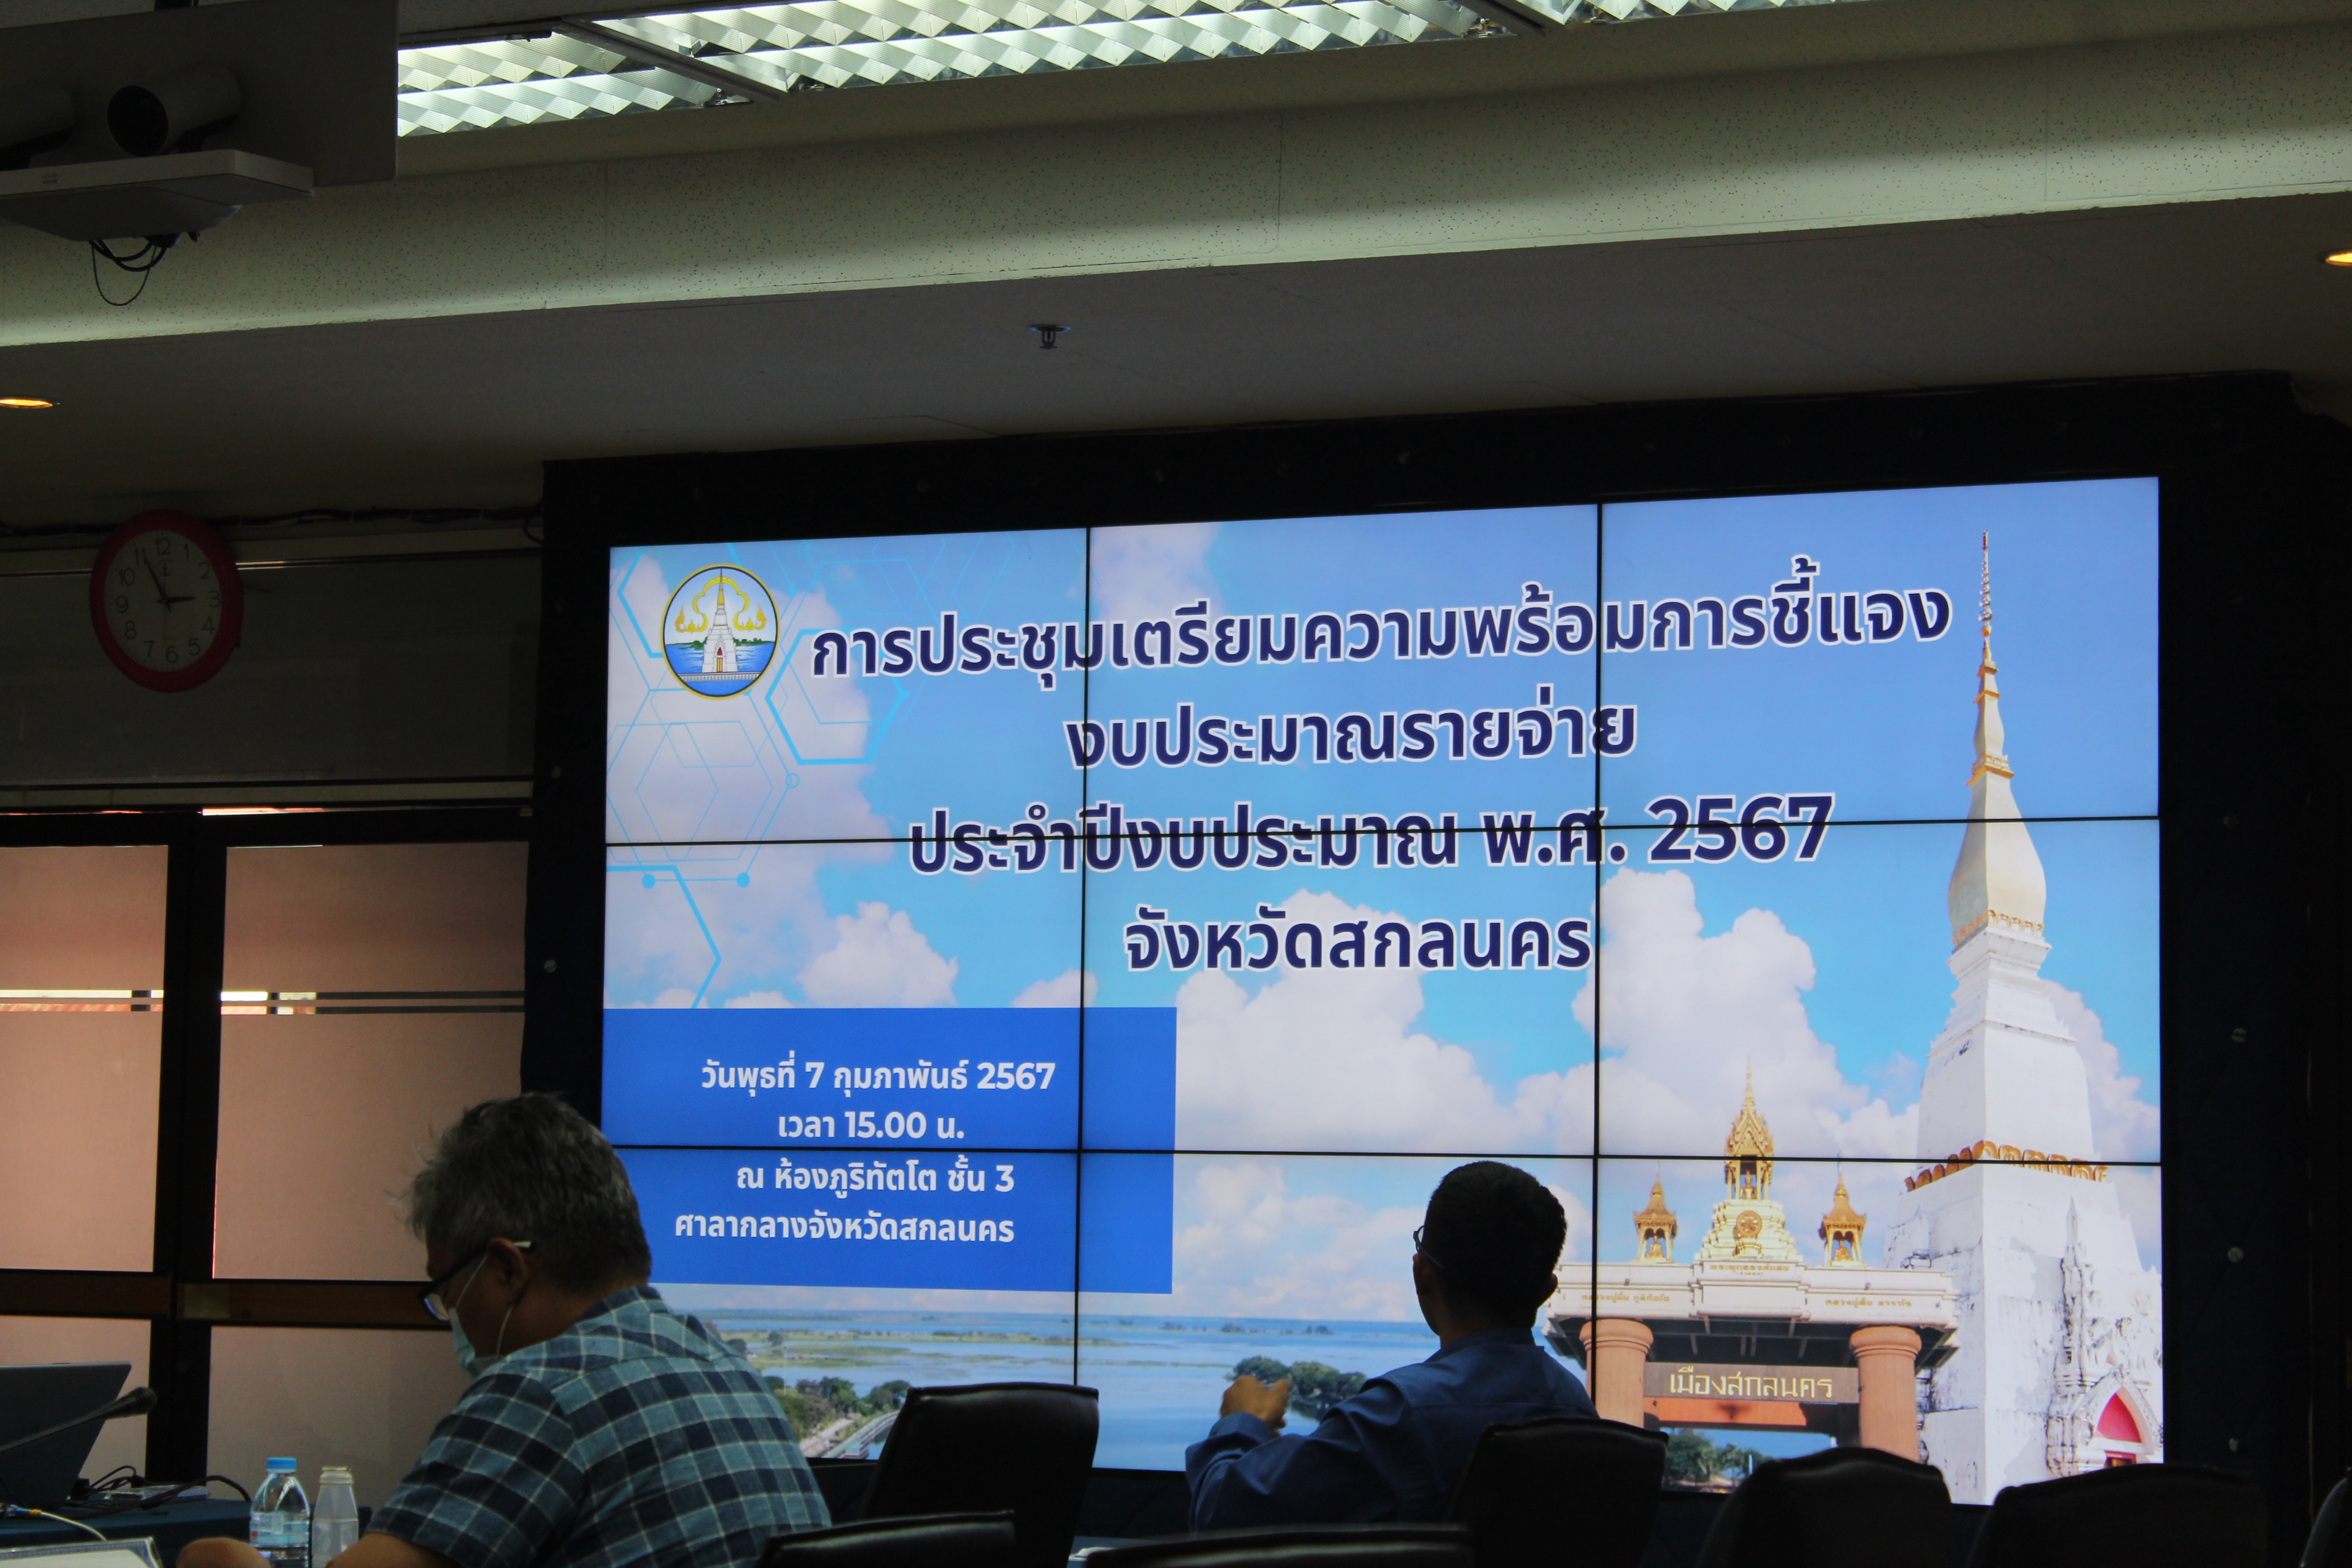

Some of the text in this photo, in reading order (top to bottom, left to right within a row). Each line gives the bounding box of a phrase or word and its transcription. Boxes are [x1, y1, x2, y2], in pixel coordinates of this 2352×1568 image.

[155, 537, 171, 555] 12
[185, 544, 189, 561] 1
[135, 548, 147, 565] 11
[118, 568, 135, 586] 10
[199, 561, 211, 579] 2
[116, 596, 128, 613] 9
[209, 590, 221, 608] 3
[125, 621, 137, 640] 8
[202, 616, 215, 634] 4
[813, 554, 1952, 691] การประชุมเตรียมความพร้อมการชี้แจง
[144, 641, 155, 657] 7
[165, 645, 178, 663] 6
[188, 638, 201, 656] 5
[1067, 686, 1635, 767] งบประมาณรายจ่าย
[911, 796, 1833, 873] ประจำปีงบประมาณ พ.ศ. 2567
[1126, 905, 1592, 970] จังหวัดสกลนคร
[701, 1050, 1055, 1098] วันพุธที่ 7 กุมภาพันธ์ 2567
[779, 1111, 965, 1139] เวลา 15.00 น.
[737, 1154, 1014, 1199] ณ ห้องภูริทัตโต ชั้น 3
[675, 1209, 1014, 1242] ศาลากลางจังหวัดสกลนคร
[1670, 1365, 1833, 1398] เมืองสกลนคร
